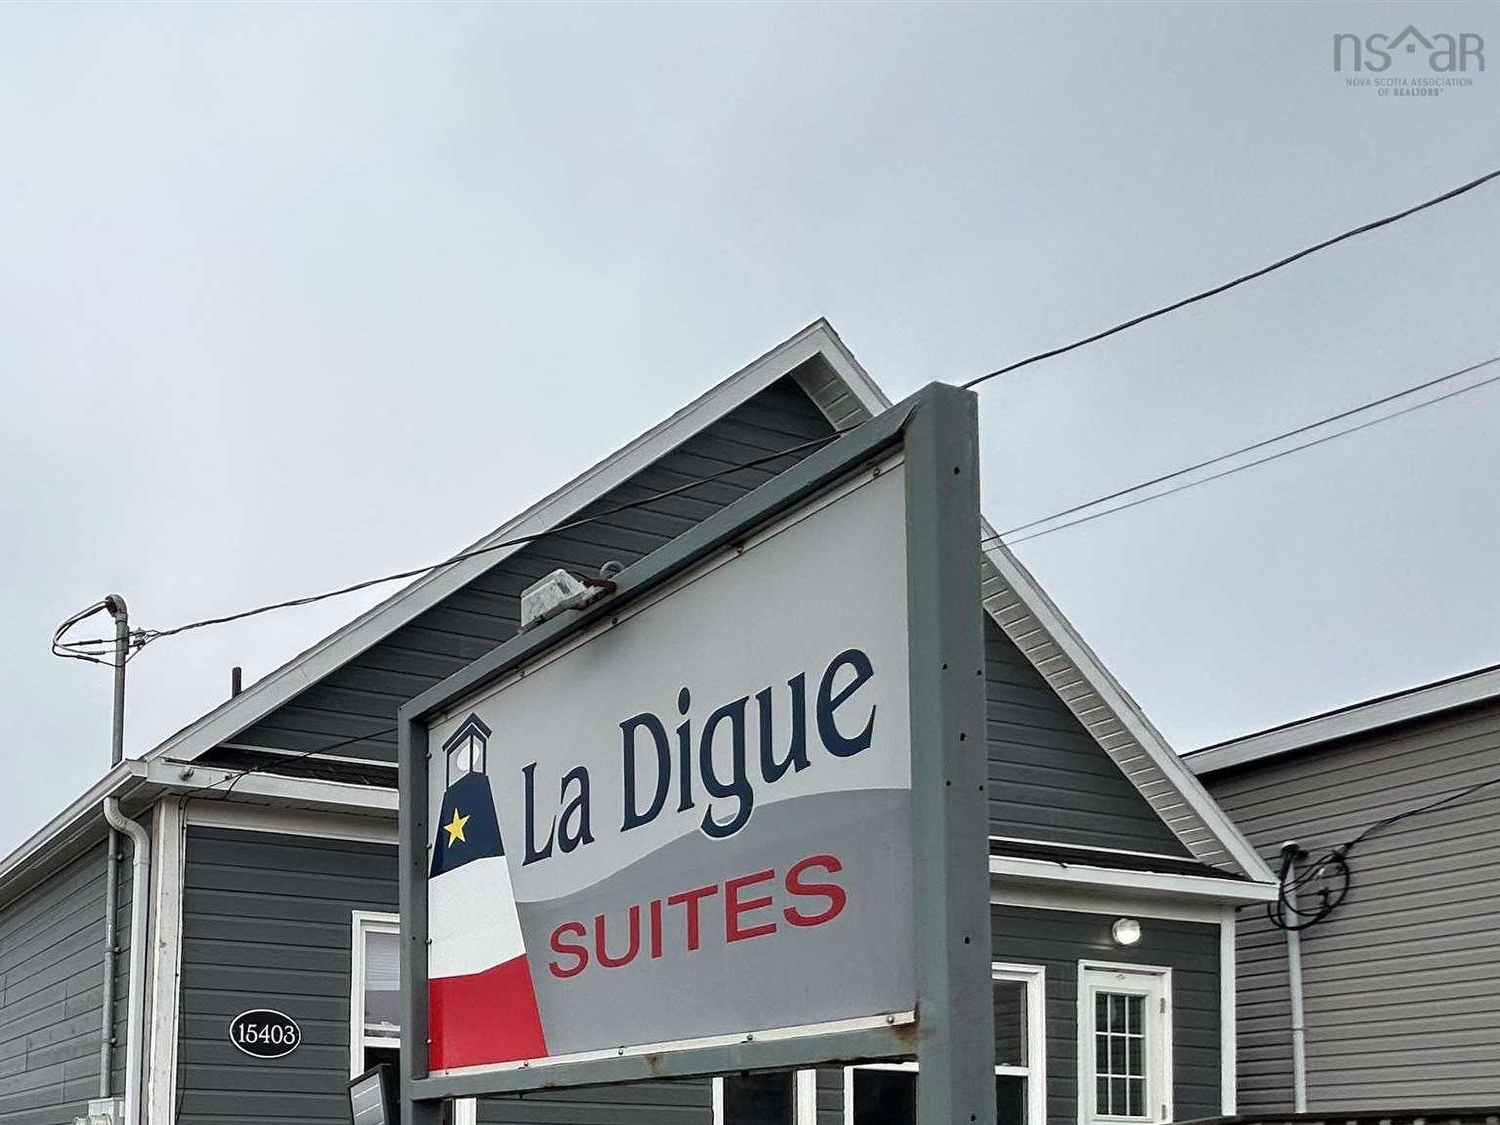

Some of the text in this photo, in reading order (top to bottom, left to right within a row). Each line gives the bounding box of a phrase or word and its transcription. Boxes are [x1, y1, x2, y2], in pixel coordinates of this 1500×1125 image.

[522, 648, 877, 866] La Digue
[548, 855, 846, 978] SUITES
[239, 1023, 296, 1044] 15403
